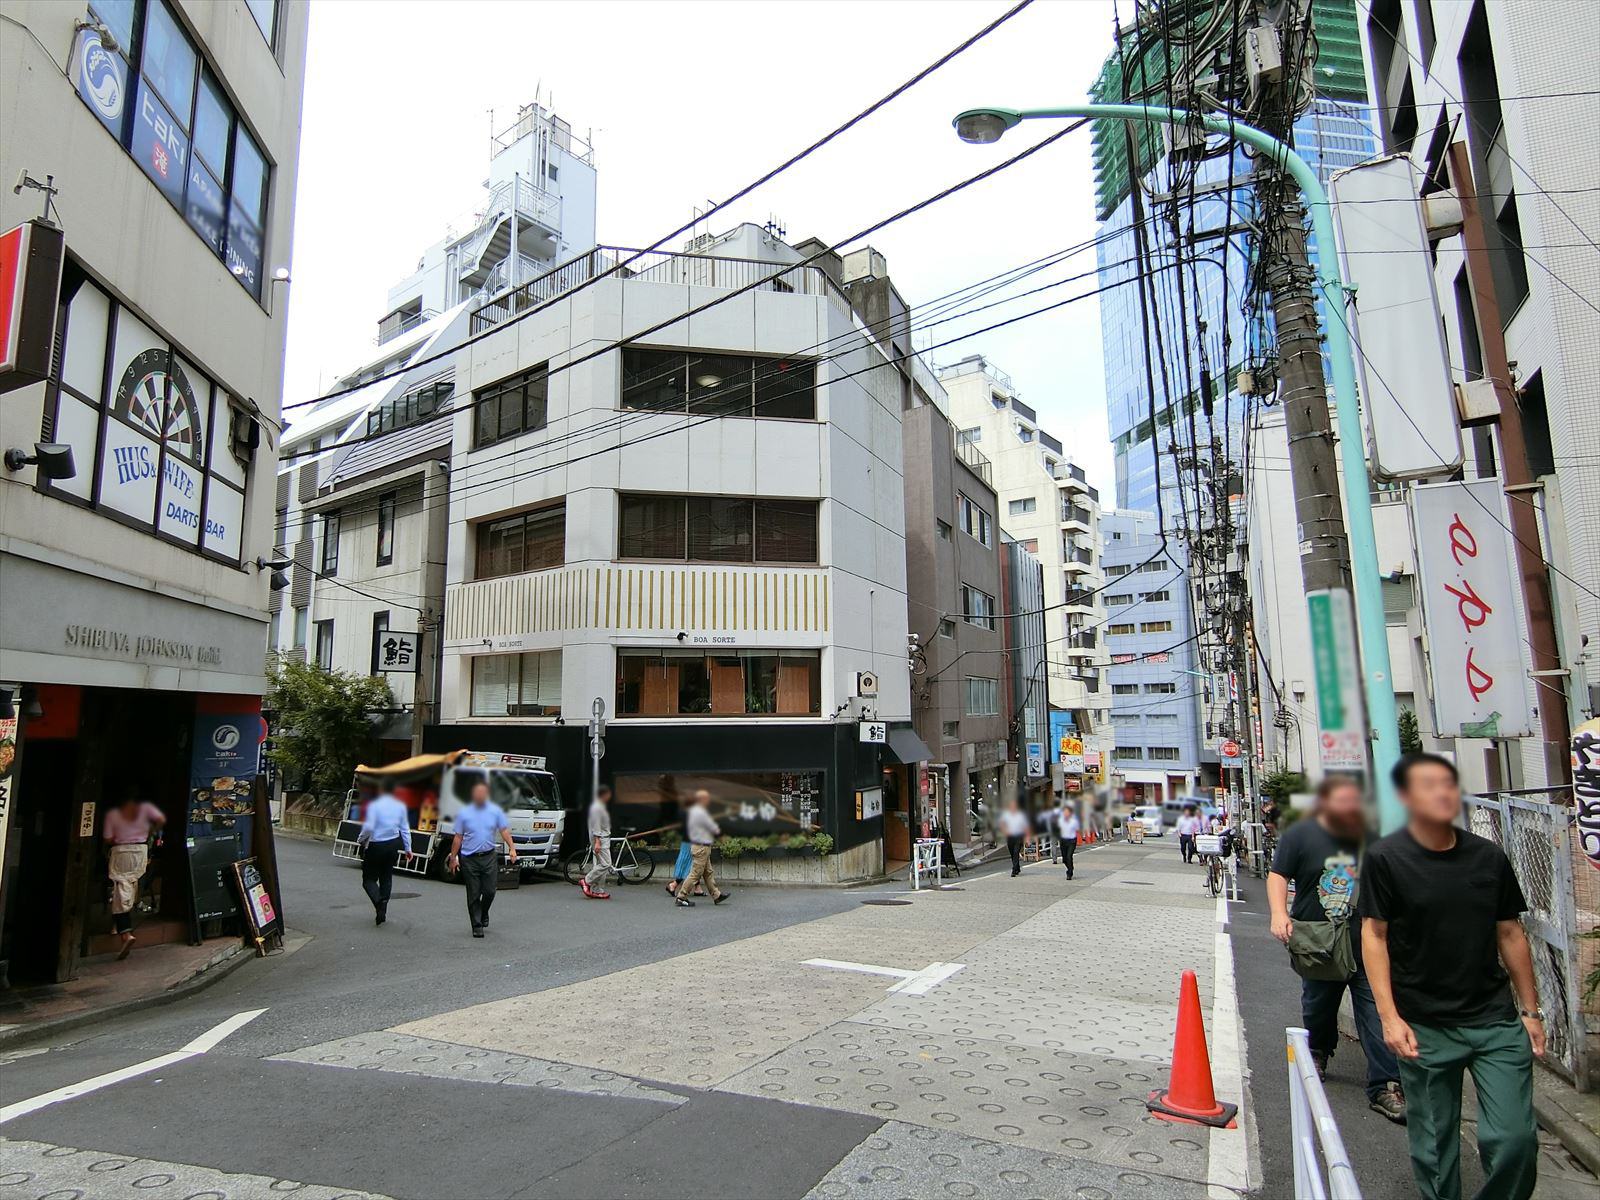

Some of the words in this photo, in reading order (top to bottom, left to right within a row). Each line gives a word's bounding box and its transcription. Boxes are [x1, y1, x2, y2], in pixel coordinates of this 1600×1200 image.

[113, 445, 150, 485] HUS
[166, 502, 200, 529] DARTS
[205, 518, 225, 540] BAR
[64, 623, 130, 654] SHIBUYA
[135, 634, 194, 662] JOHNSON
[382, 636, 414, 666] 鮨
[712, 636, 736, 644] SORTE
[1061, 738, 1082, 754] 焼肉
